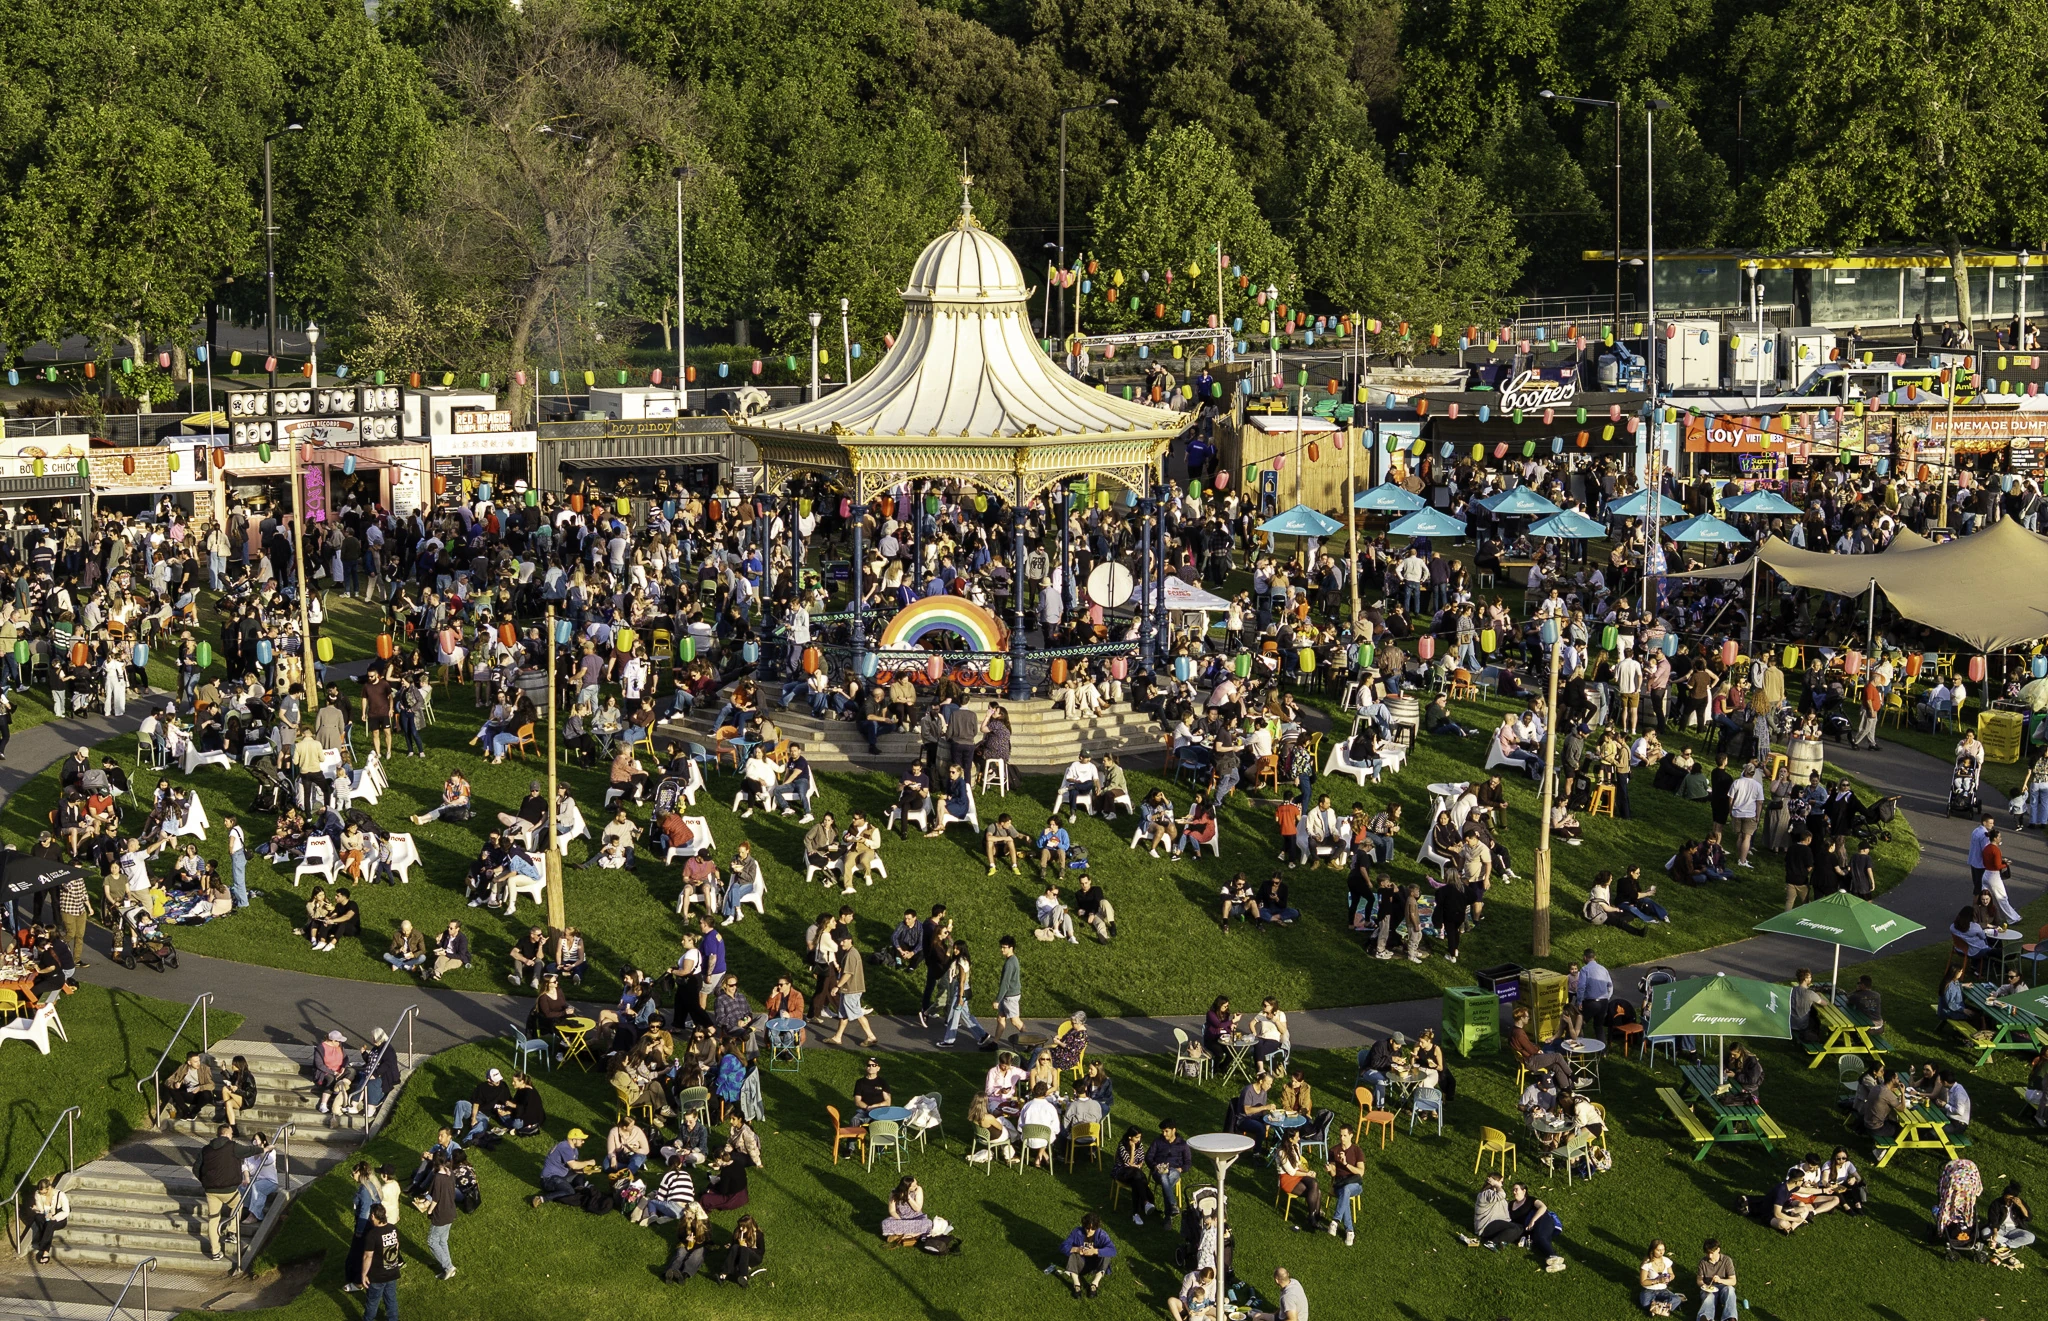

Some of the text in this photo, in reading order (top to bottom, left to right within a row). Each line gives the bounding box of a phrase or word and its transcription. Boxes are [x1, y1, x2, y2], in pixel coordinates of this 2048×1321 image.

[1897, 379, 1933, 387] Emerge
[1500, 370, 1575, 413] Coopers
[316, 420, 340, 428] RECORDS
[456, 412, 511, 425] RED DRAGON
[456, 423, 511, 433] DUMPLING HOUSE
[612, 422, 672, 435] hoy pinoy
[2011, 421, 2048, 430] DUMP
[20, 462, 81, 474] BOS CHICK
[1796, 918, 1844, 935] Tanqueray
[1497, 986, 1516, 994] Reusable
[1691, 1013, 1746, 1026] Tanqueray
